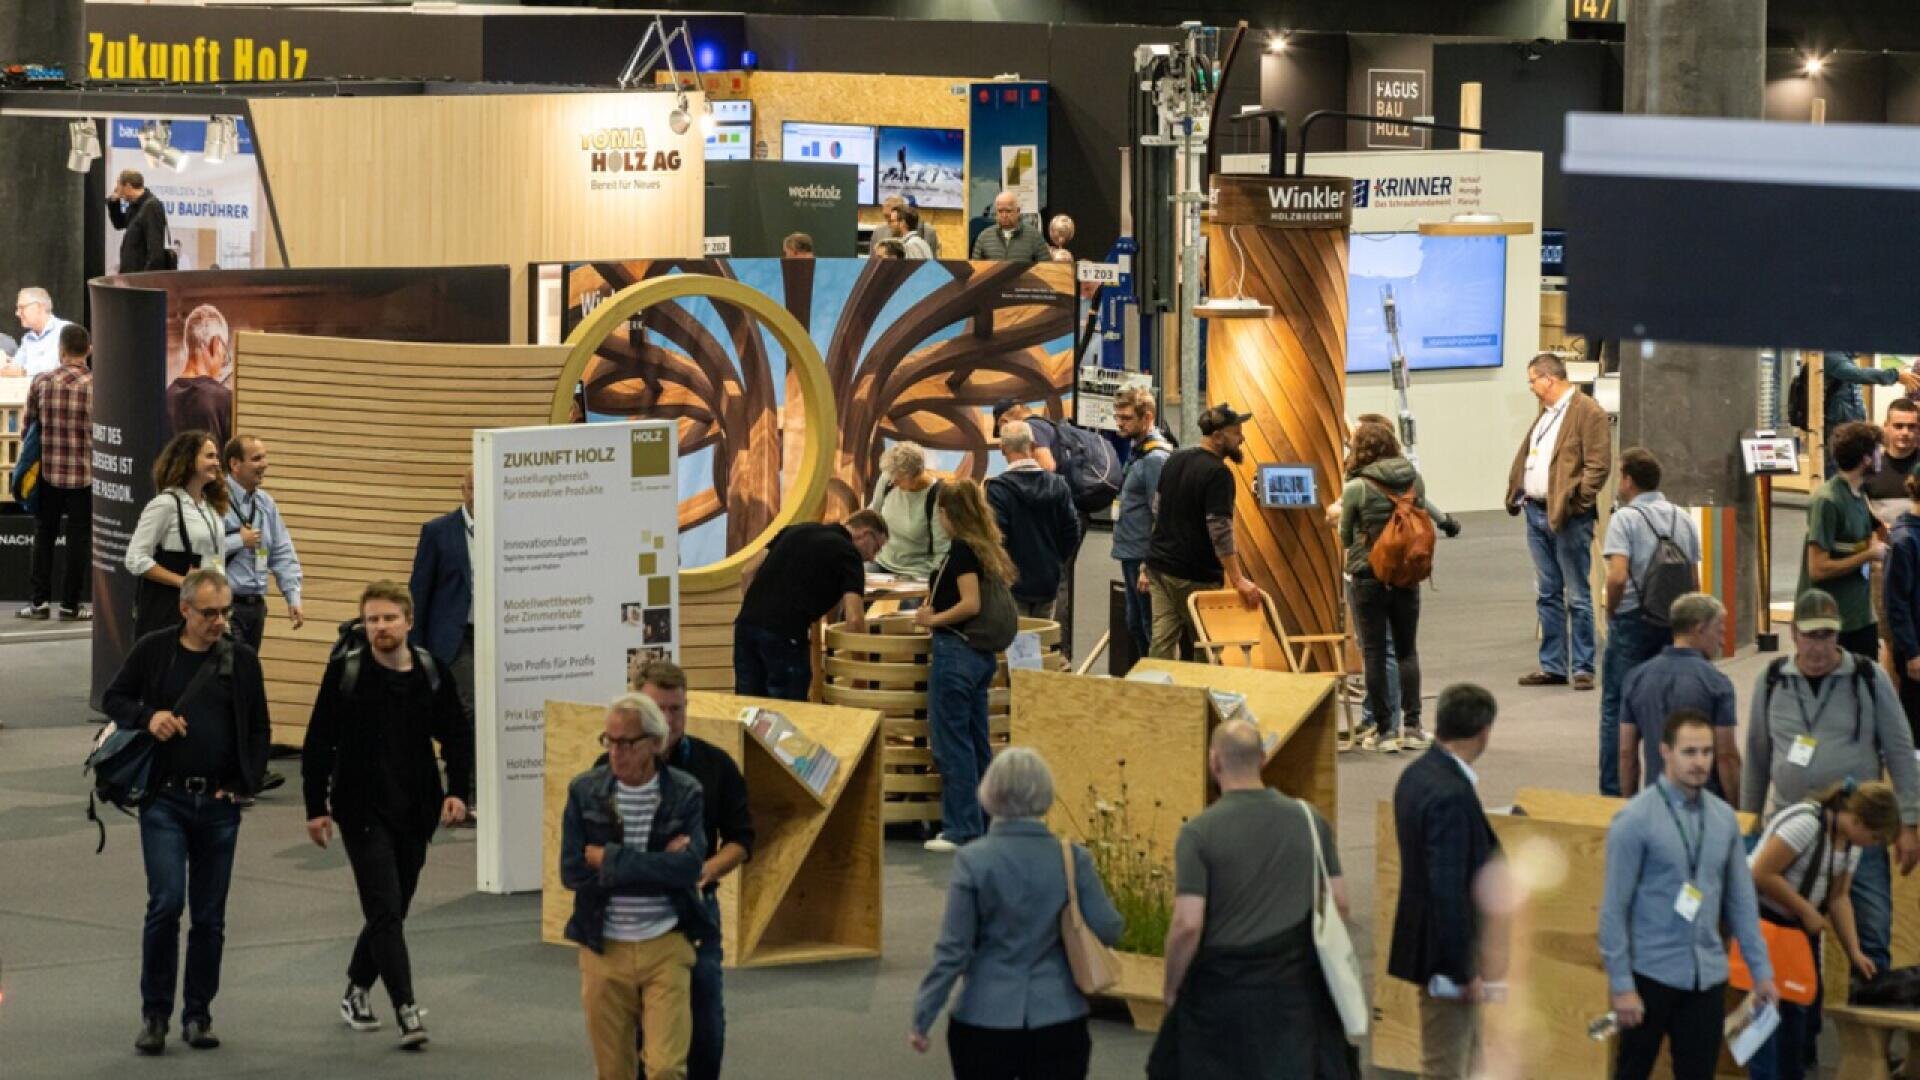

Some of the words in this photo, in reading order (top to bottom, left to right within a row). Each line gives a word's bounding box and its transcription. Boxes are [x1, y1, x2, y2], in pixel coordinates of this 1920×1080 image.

[1574, 0, 1611, 18] 147
[88, 32, 220, 82] Zukunft
[233, 37, 308, 81] Holz
[1376, 80, 1419, 99] FAGUS
[1376, 99, 1403, 117] BAU
[1376, 121, 1410, 136] HOLZ
[579, 126, 648, 151] TOMA
[591, 150, 648, 173] HOLZ
[653, 149, 682, 171] AG
[788, 183, 842, 200] werkholz
[1374, 176, 1452, 197] KRINNER
[1268, 185, 1345, 208] Winkler
[178, 199, 249, 220] BAUFÜHRER
[632, 431, 663, 442] HOLZ
[503, 449, 573, 469] ZUKUNFT
[575, 446, 616, 464] HOLZ
[503, 470, 590, 485] Ausstellungsbereich
[503, 488, 517, 500] für
[518, 487, 563, 499] innovative
[565, 484, 604, 497] Produkte
[503, 535, 588, 550] Innovationsforum
[503, 593, 594, 610] Modellwettbewerb
[503, 612, 519, 624] der
[521, 607, 583, 623] Zimmerleute
[503, 660, 522, 673] Von
[524, 656, 552, 672] Profis
[553, 656, 567, 669] für
[569, 653, 595, 667] Profis
[504, 708, 522, 721] Prix
[524, 708, 544, 722] Lign
[506, 757, 544, 769] Holzhoc
